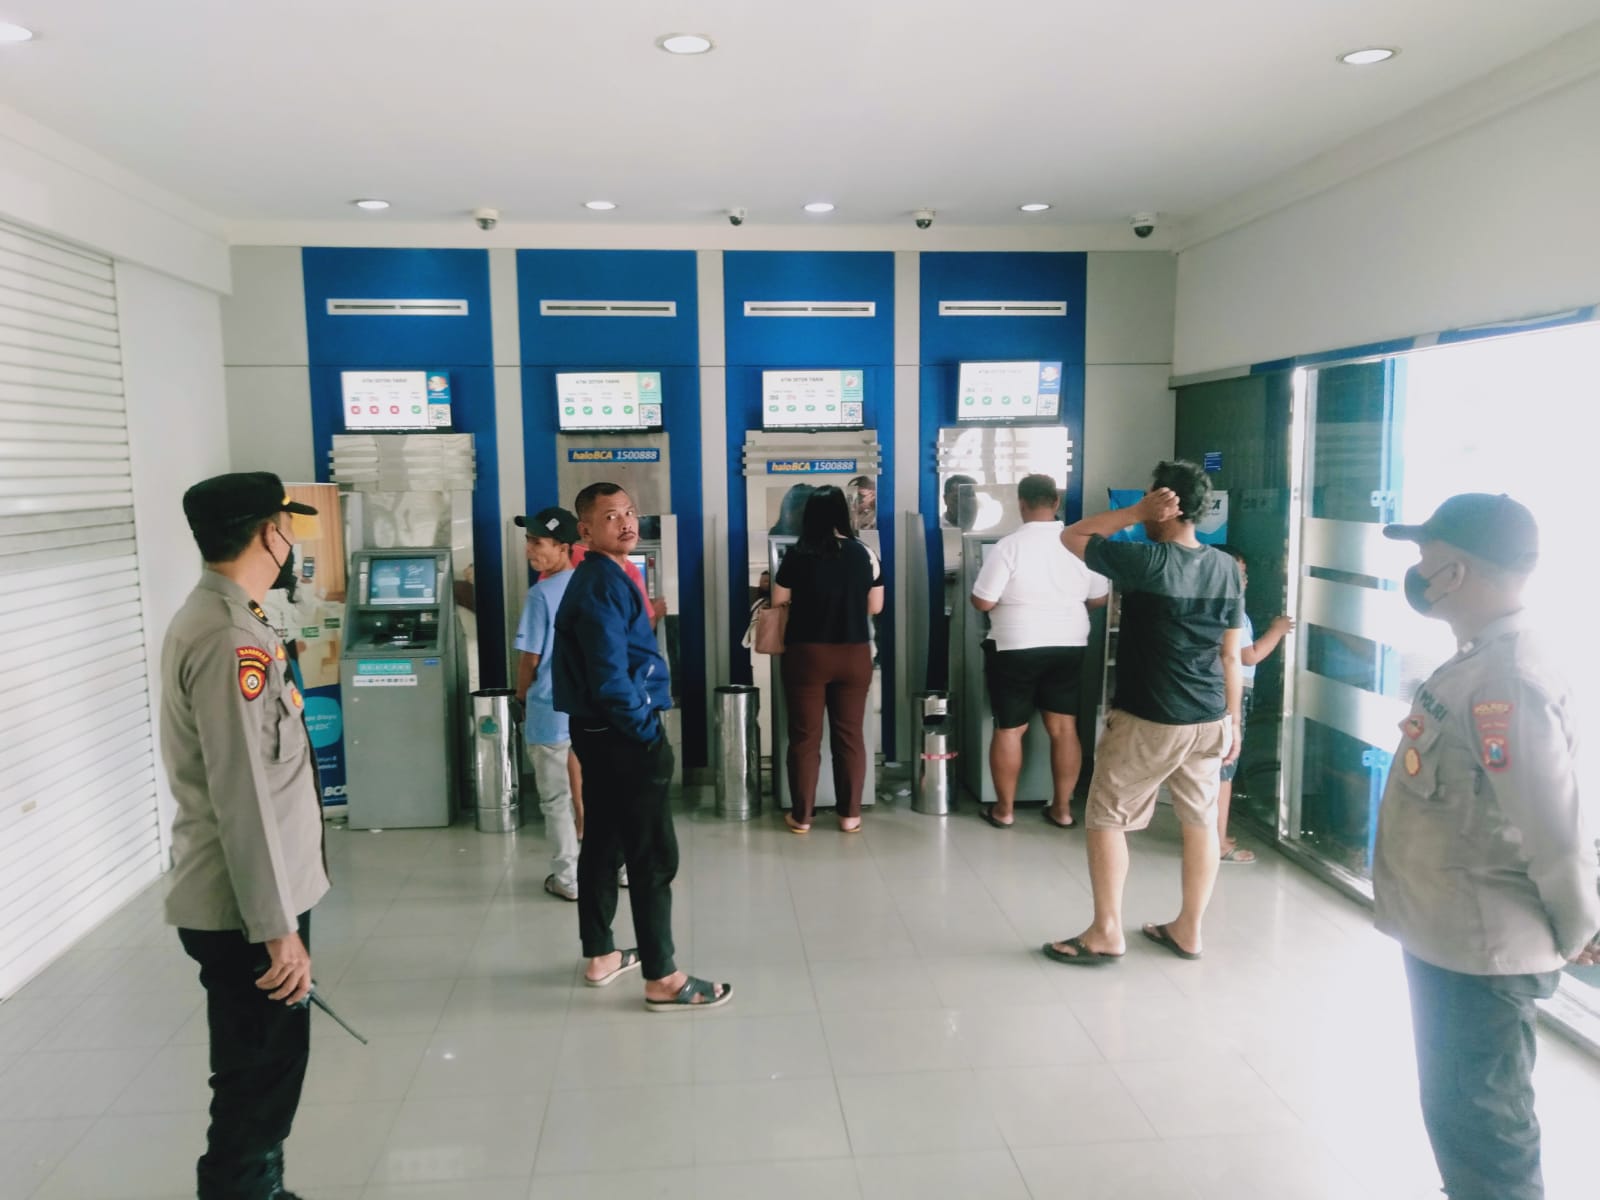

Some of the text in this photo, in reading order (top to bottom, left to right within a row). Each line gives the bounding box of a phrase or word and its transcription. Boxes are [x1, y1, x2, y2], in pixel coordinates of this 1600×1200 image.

[573, 451, 658, 460] haloBCA 1500888
[772, 461, 854, 471] haloBCA 1500888
[1420, 691, 1448, 720] POLRI
